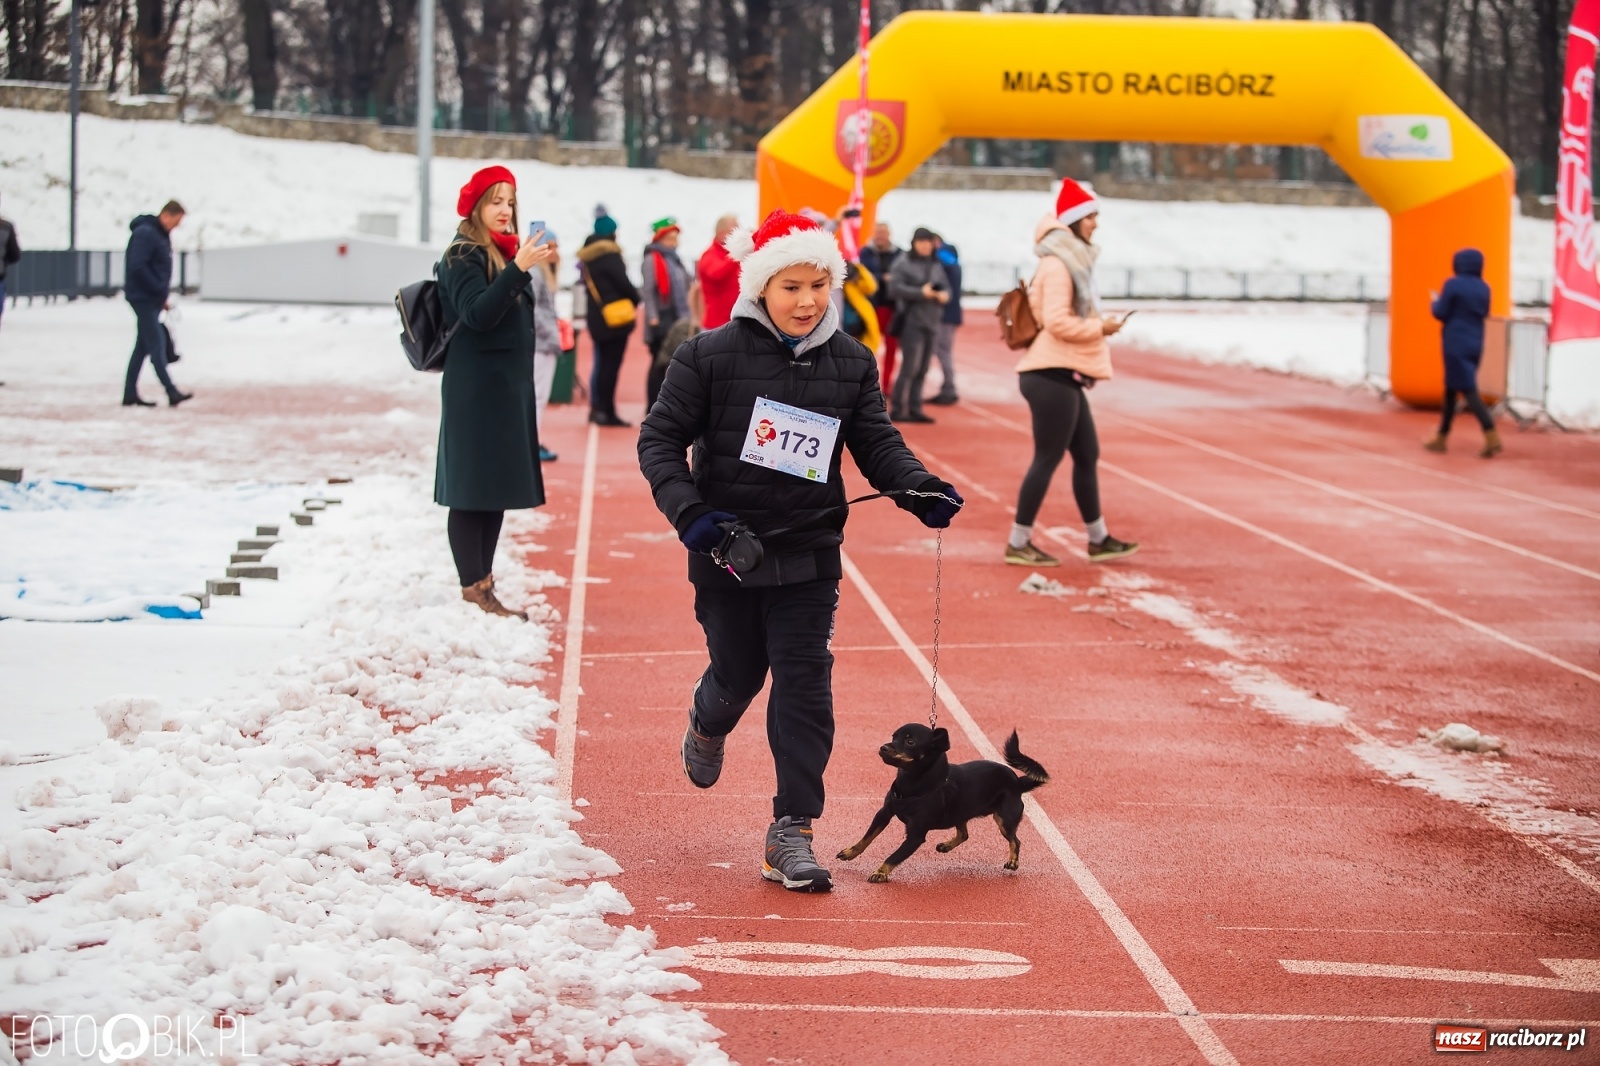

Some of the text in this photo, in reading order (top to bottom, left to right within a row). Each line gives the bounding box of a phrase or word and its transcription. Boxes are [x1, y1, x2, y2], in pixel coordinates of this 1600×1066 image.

[1003, 69, 1276, 98] MIASTO RACIBÓRZ
[780, 430, 820, 458] 173
